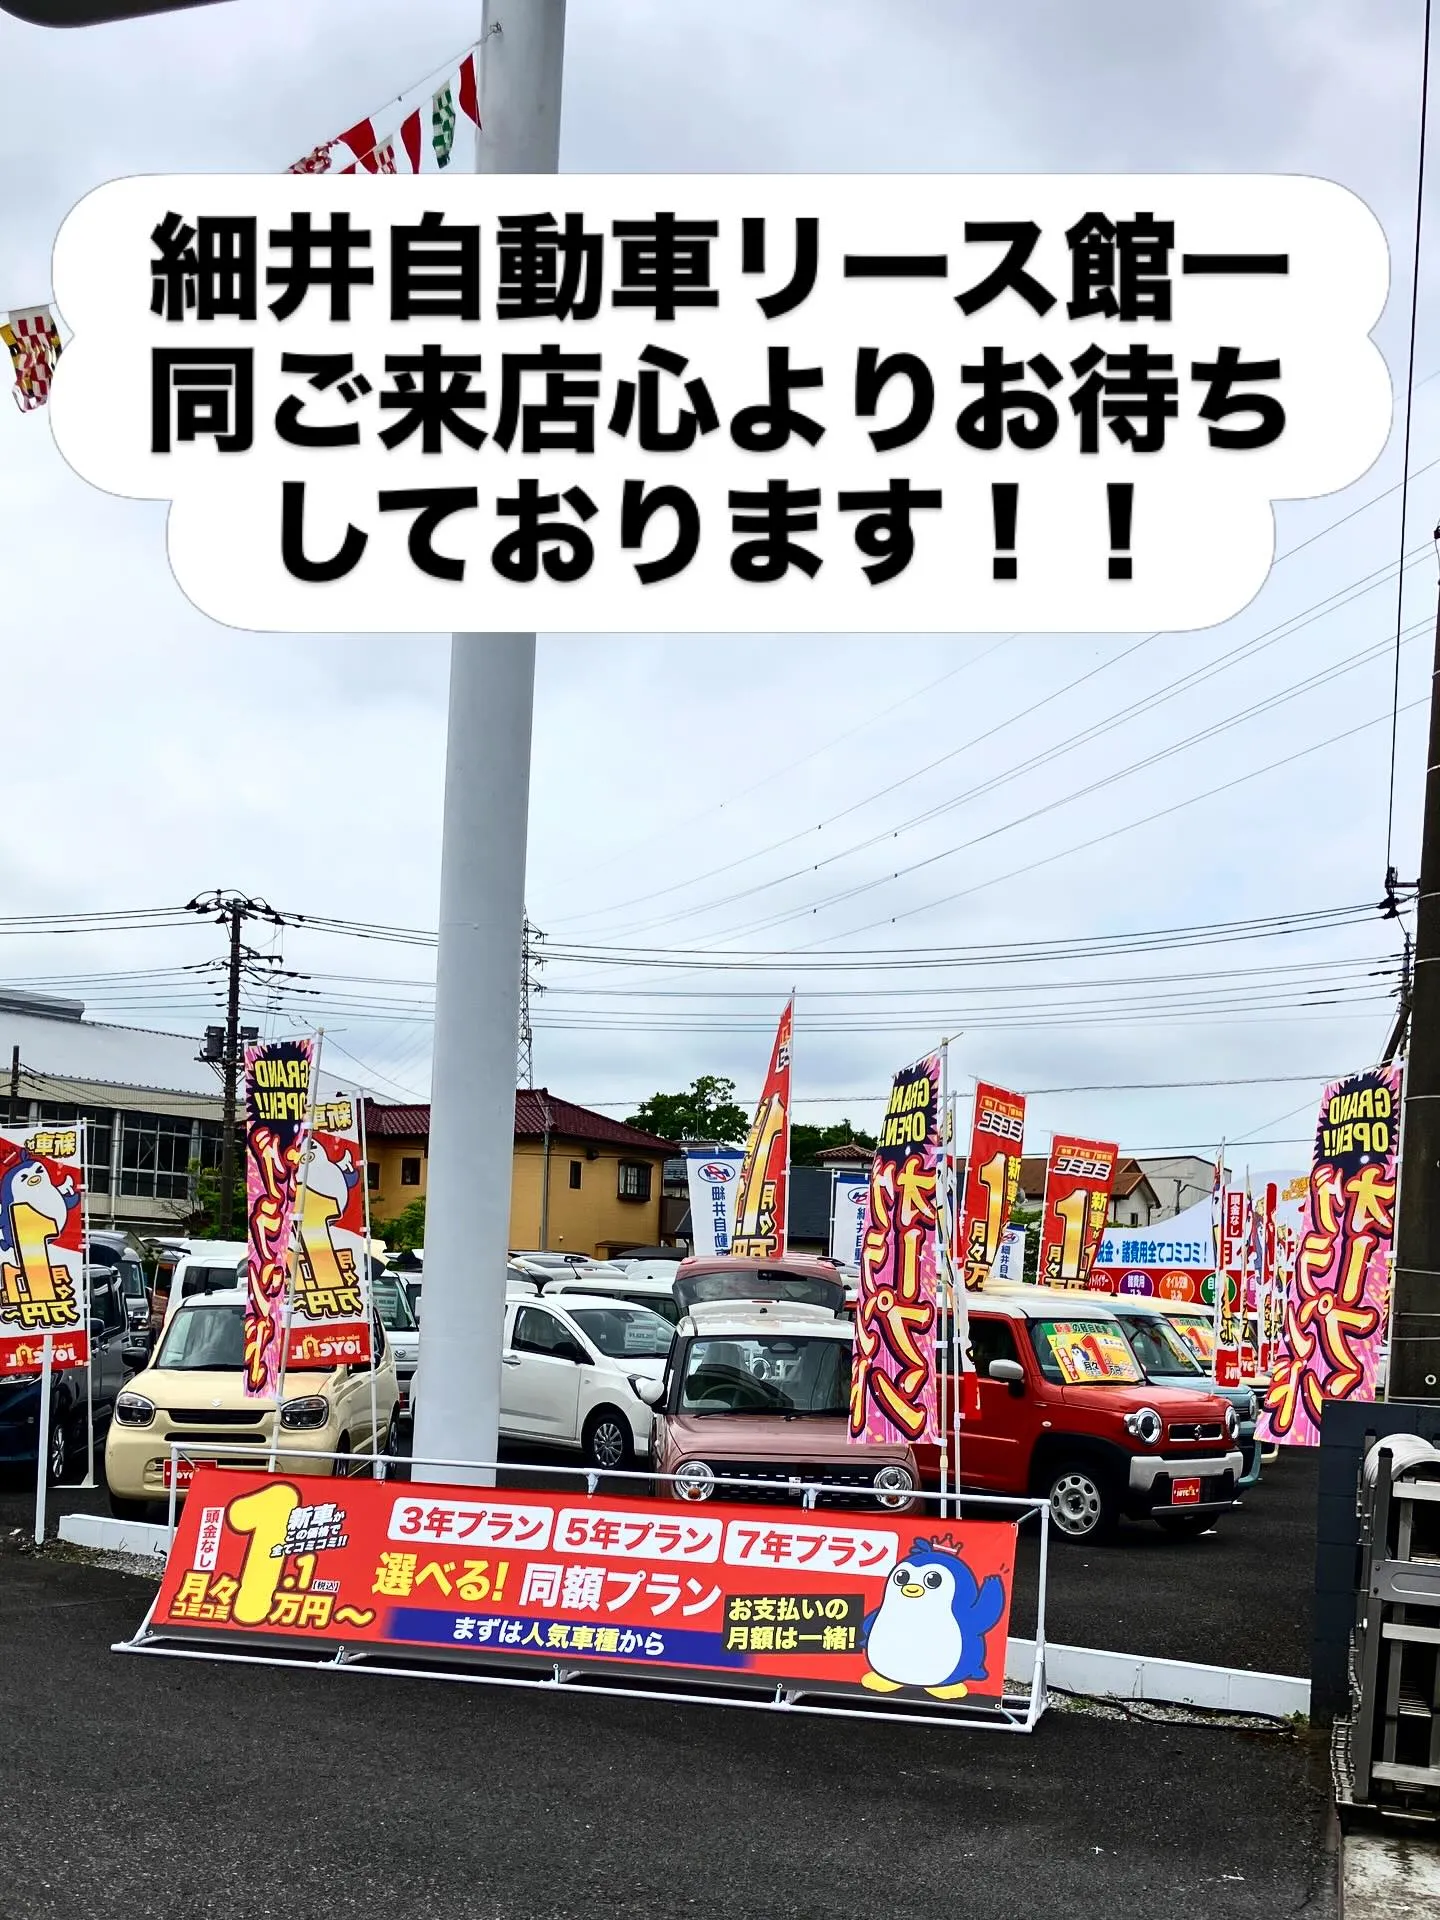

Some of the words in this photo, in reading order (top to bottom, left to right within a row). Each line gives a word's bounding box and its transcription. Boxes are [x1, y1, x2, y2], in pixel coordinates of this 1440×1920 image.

[978, 1111, 1023, 1139] コミコミ
[1054, 1158, 1110, 1178] コミコミ
[1229, 1194, 1240, 1236] 頭金なし
[288, 1503, 345, 1530] 新車が
[399, 1506, 544, 1541] 3年プラン
[199, 1510, 220, 1568] 頭金なし
[285, 1526, 341, 1542] この価格で
[564, 1518, 713, 1555] 5年プラン
[737, 1530, 889, 1567] 7年プラン
[176, 1571, 239, 1605] 月々
[519, 1562, 722, 1617] 同額プラン
[171, 1602, 230, 1621] コミコミ
[728, 1598, 849, 1621] お支払いの
[453, 1616, 665, 1656] まずは人気車種から
[726, 1626, 856, 1651] 月額は一緒!
